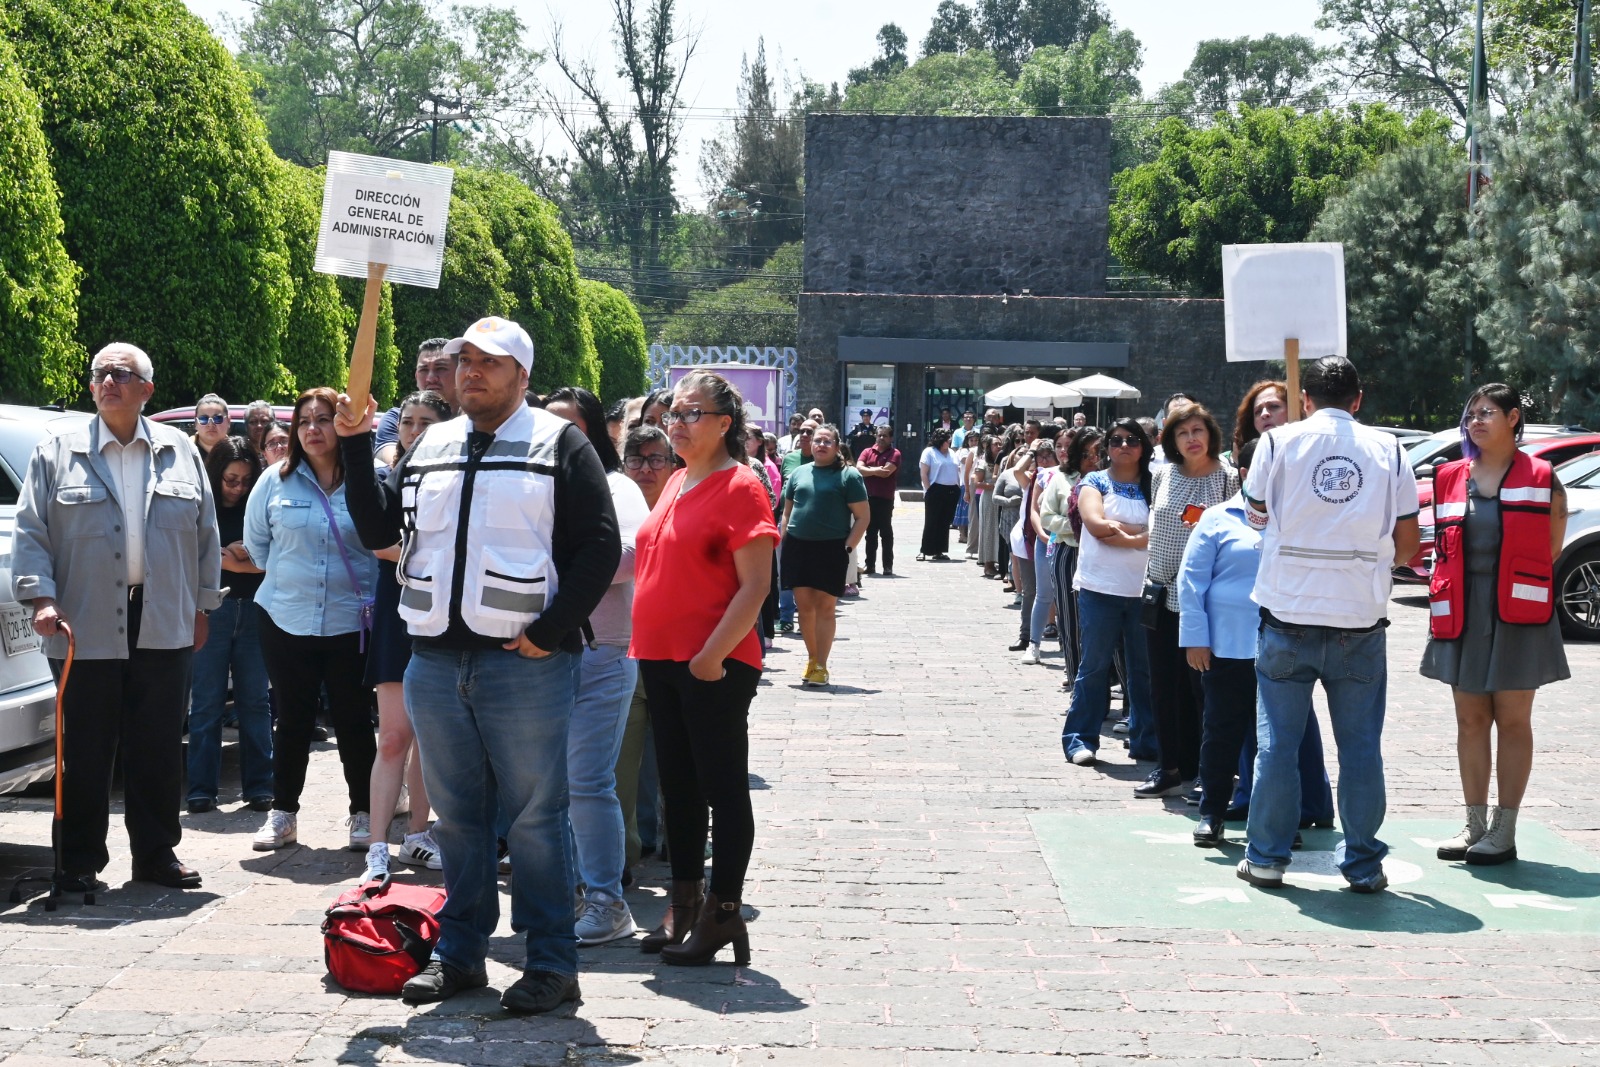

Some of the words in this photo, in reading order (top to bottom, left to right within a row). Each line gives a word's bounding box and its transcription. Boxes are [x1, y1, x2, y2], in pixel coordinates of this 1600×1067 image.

[355, 189, 421, 208] DIRECCIÓN
[347, 206, 404, 223] GENERAL
[408, 213, 424, 226] DE
[332, 221, 434, 245] ADMINISTRACIÓN
